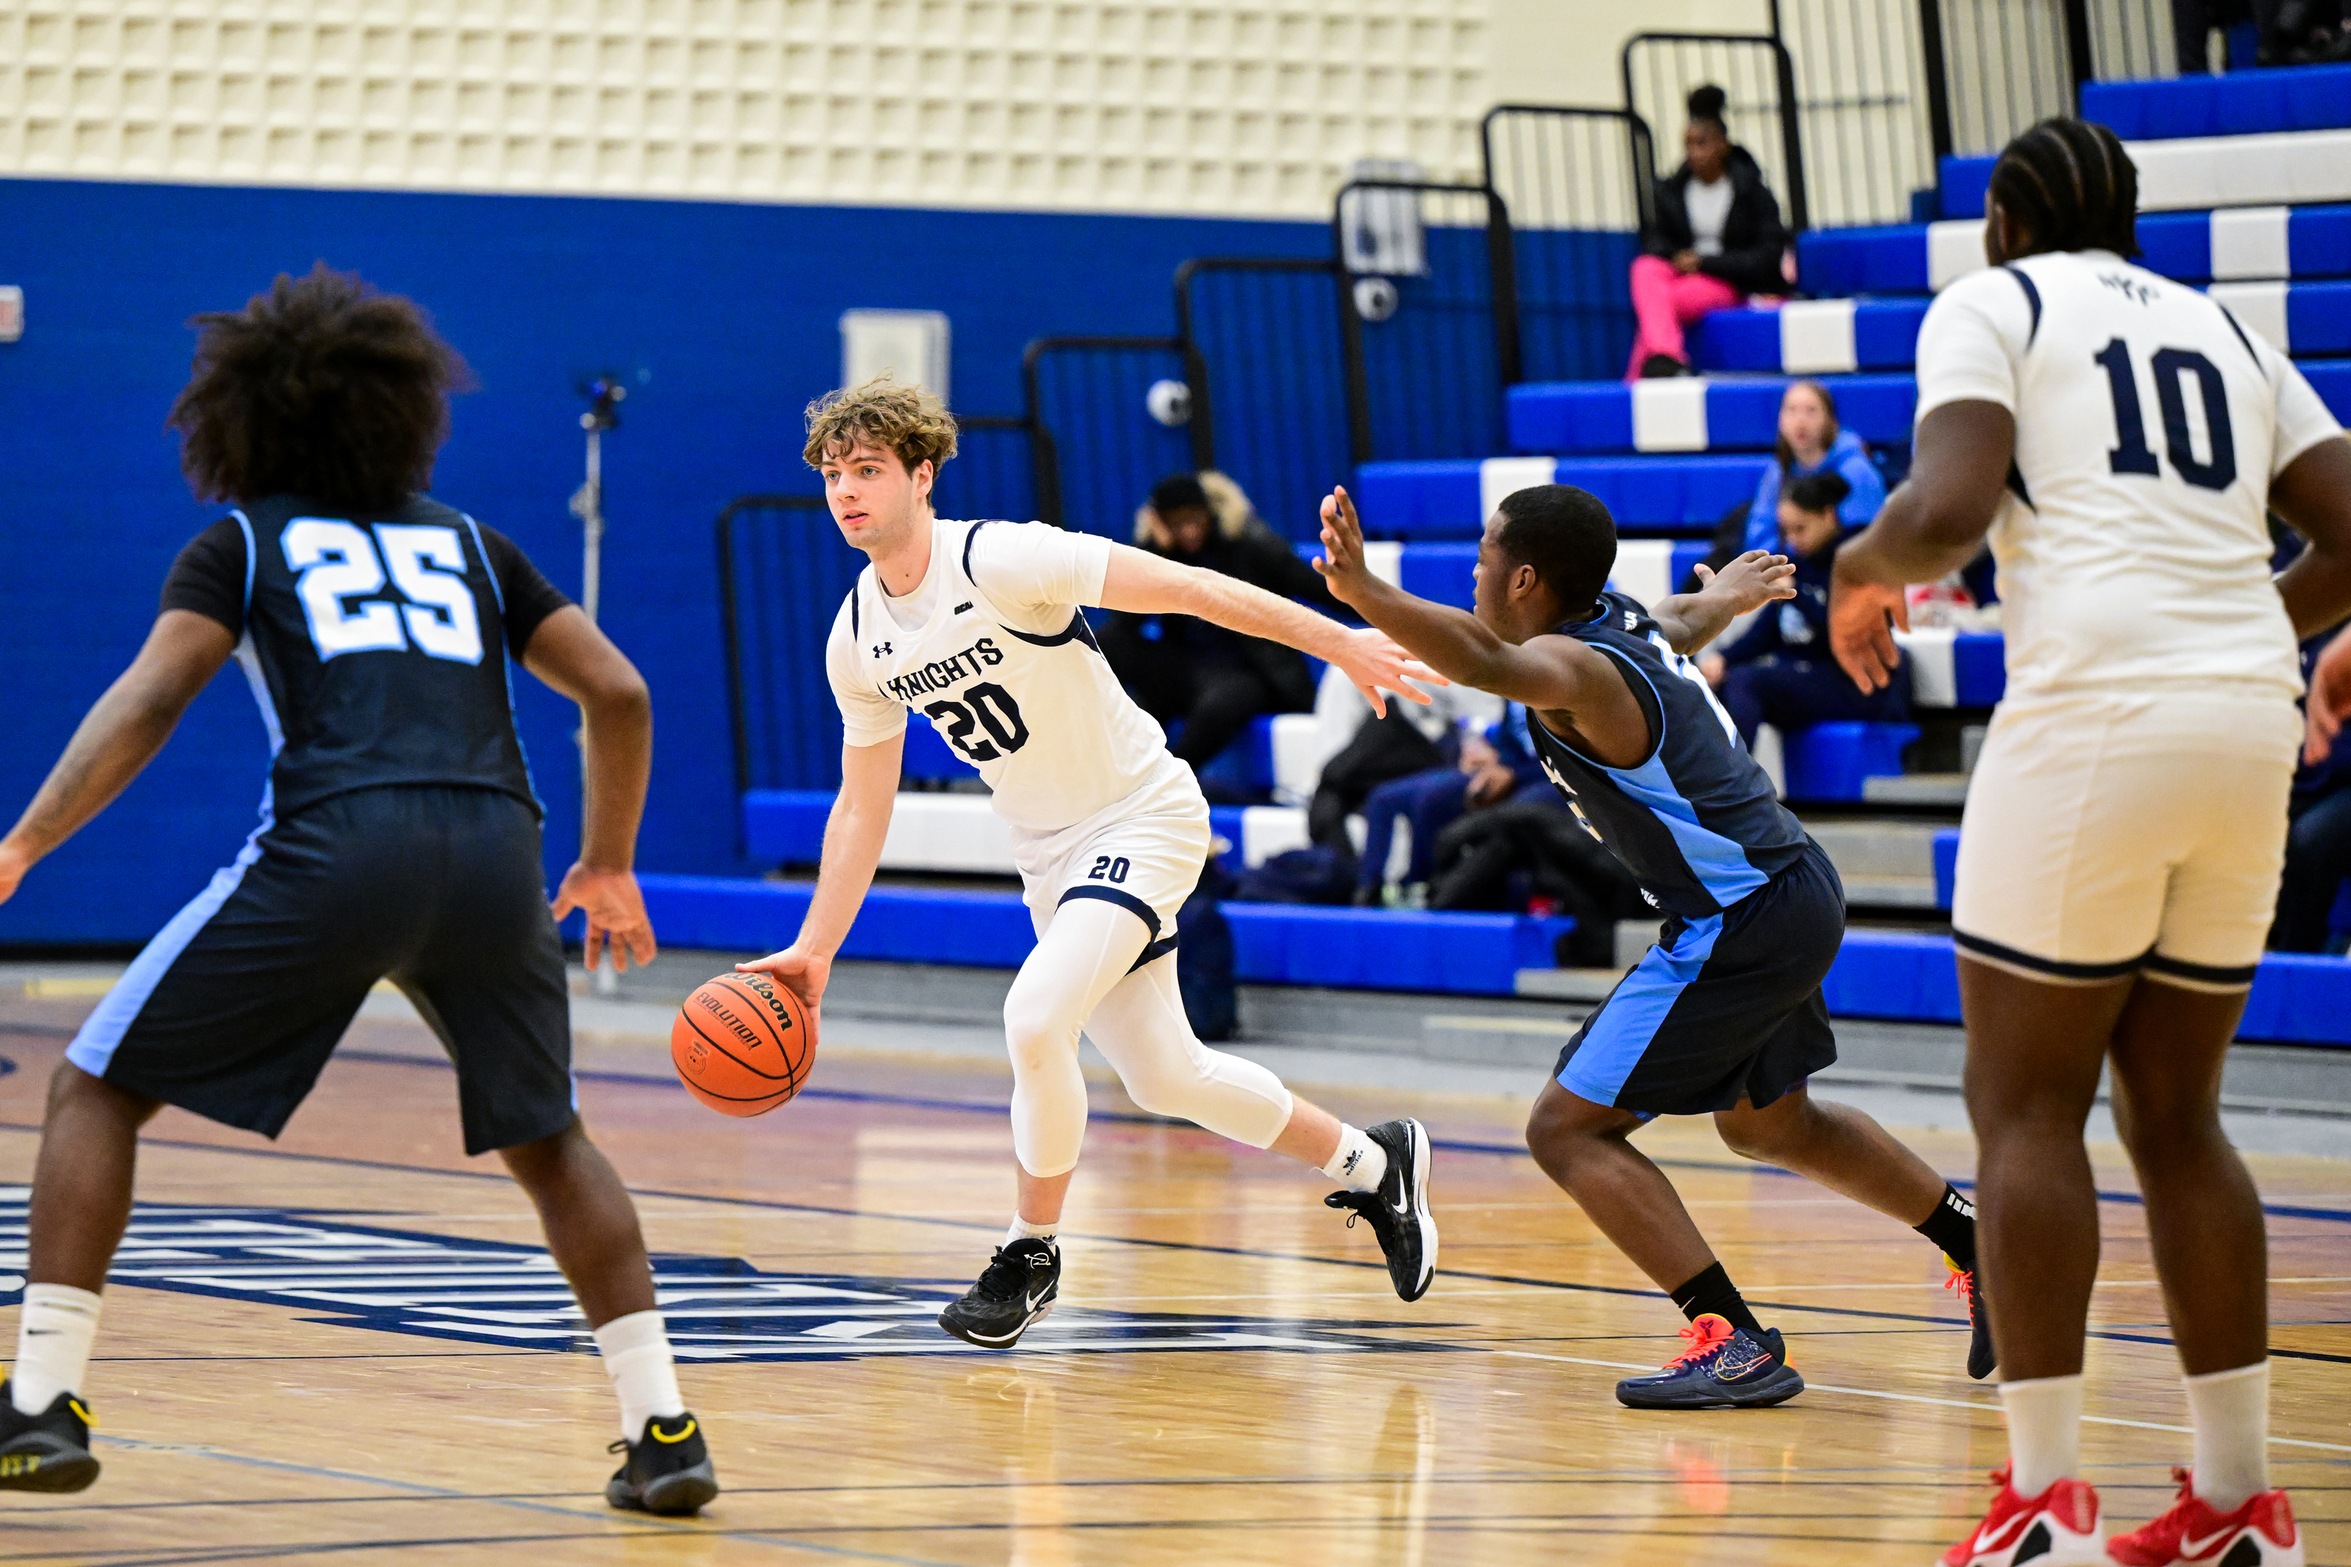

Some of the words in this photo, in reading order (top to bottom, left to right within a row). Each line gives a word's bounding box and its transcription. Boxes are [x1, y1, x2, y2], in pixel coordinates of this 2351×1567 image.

[2094, 337, 2237, 493] 10
[279, 515, 486, 667] 25
[886, 637, 1004, 702] KNIGHTS
[924, 681, 1030, 762] 20
[1087, 855, 1131, 884] 20
[695, 991, 763, 1050] EVOLUTION
